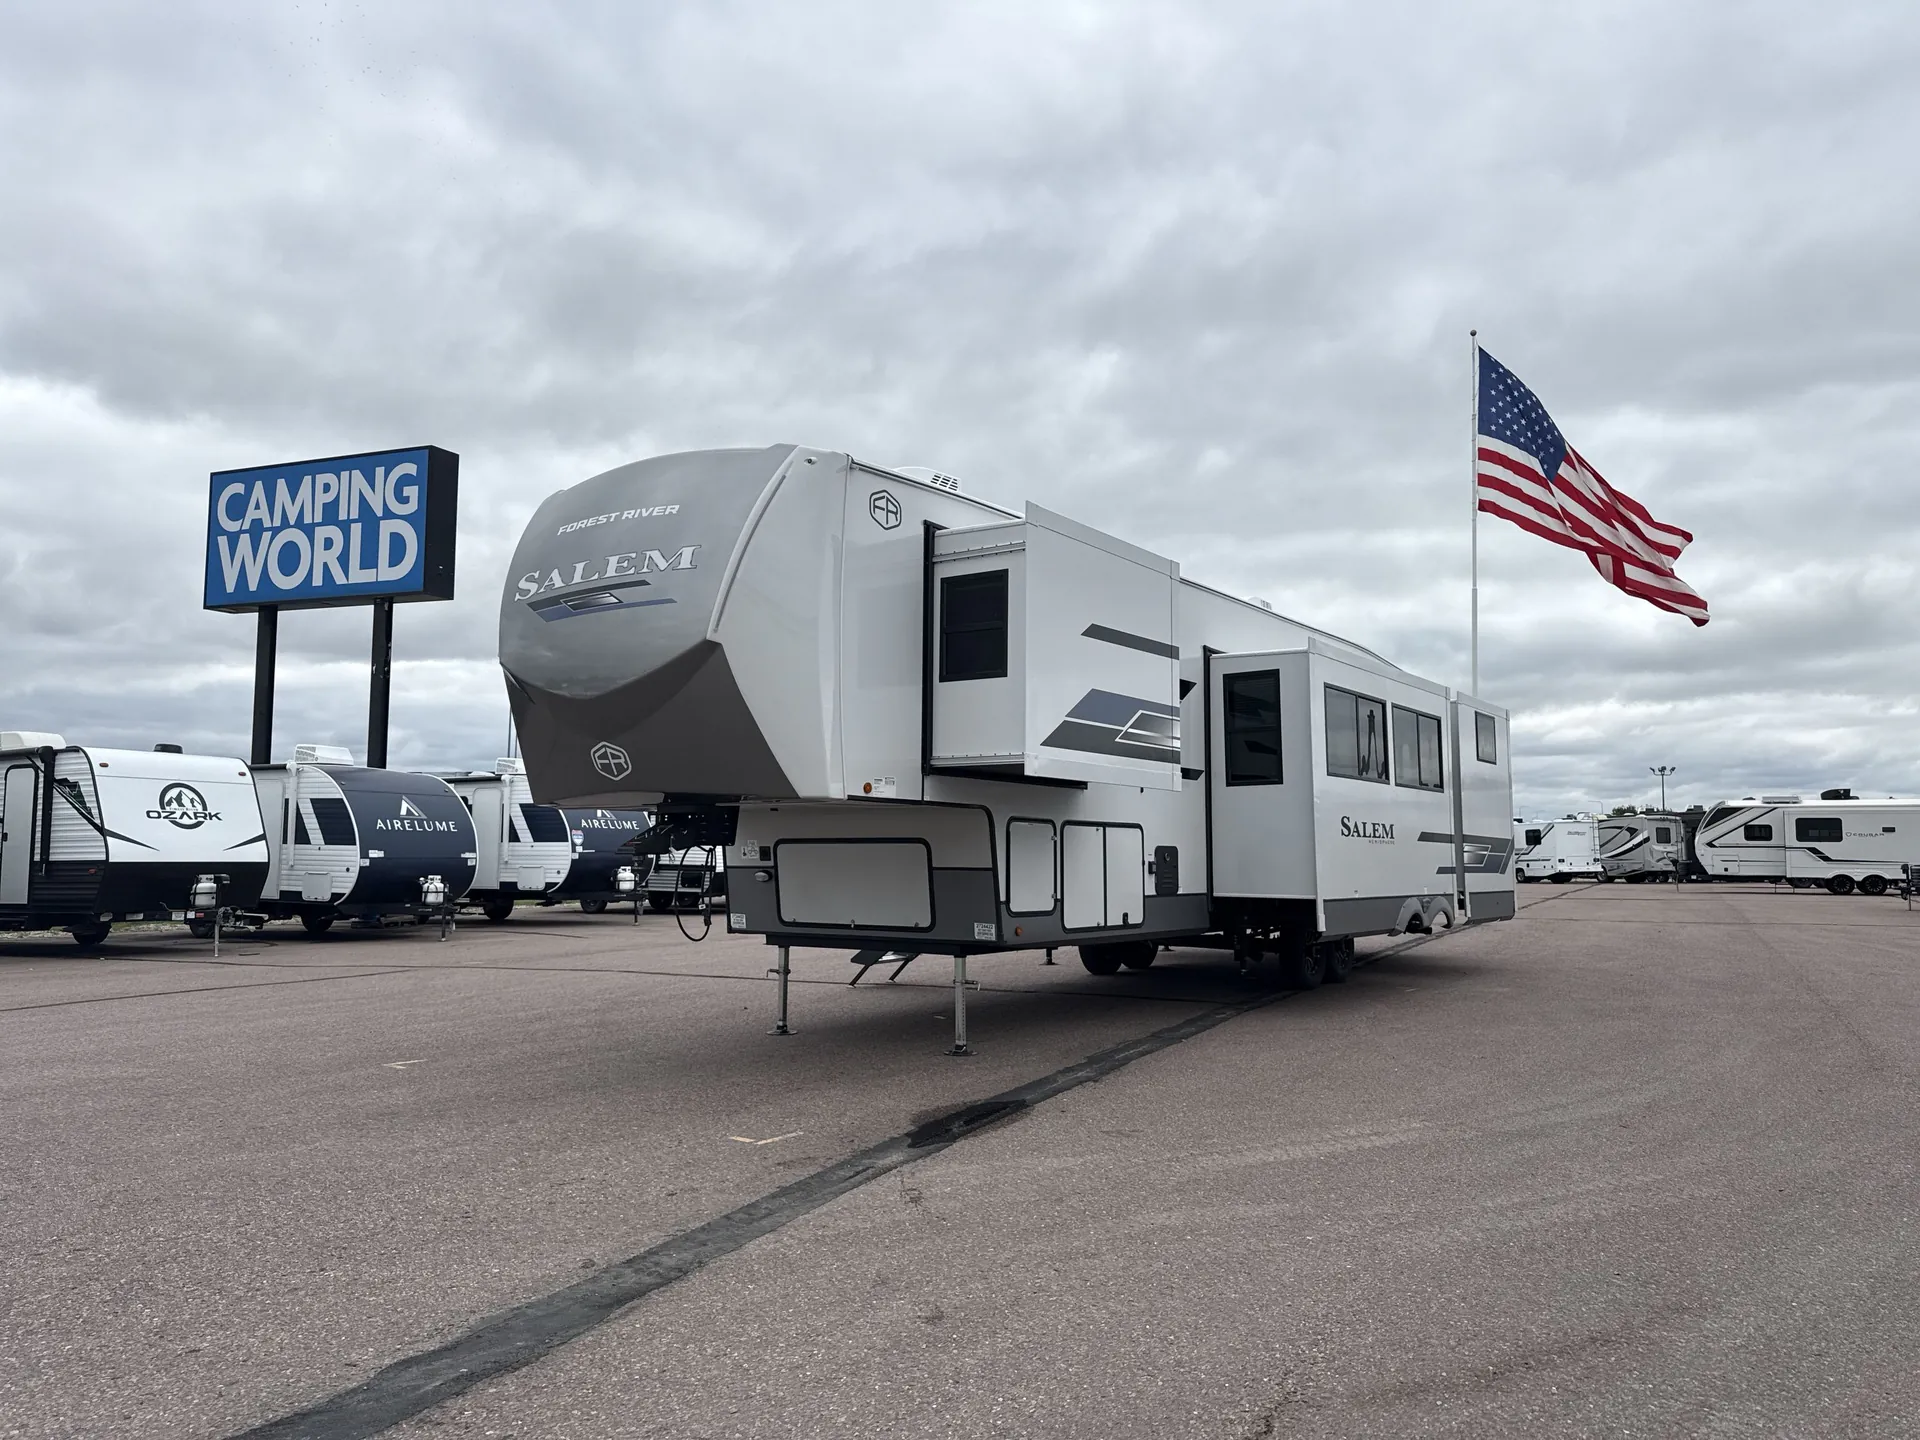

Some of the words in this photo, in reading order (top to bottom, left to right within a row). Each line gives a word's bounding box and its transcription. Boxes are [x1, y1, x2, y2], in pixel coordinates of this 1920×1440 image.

[217, 463, 419, 532] CAMPING
[557, 506, 620, 535] FOREST
[622, 505, 680, 520] RIVER
[217, 518, 418, 593] WORLD
[514, 544, 702, 602] SALEM
[146, 810, 223, 821] OZARK
[376, 819, 458, 832] AIRELUME
[581, 819, 639, 830] AIRELUME
[1341, 815, 1395, 839] SALEM
